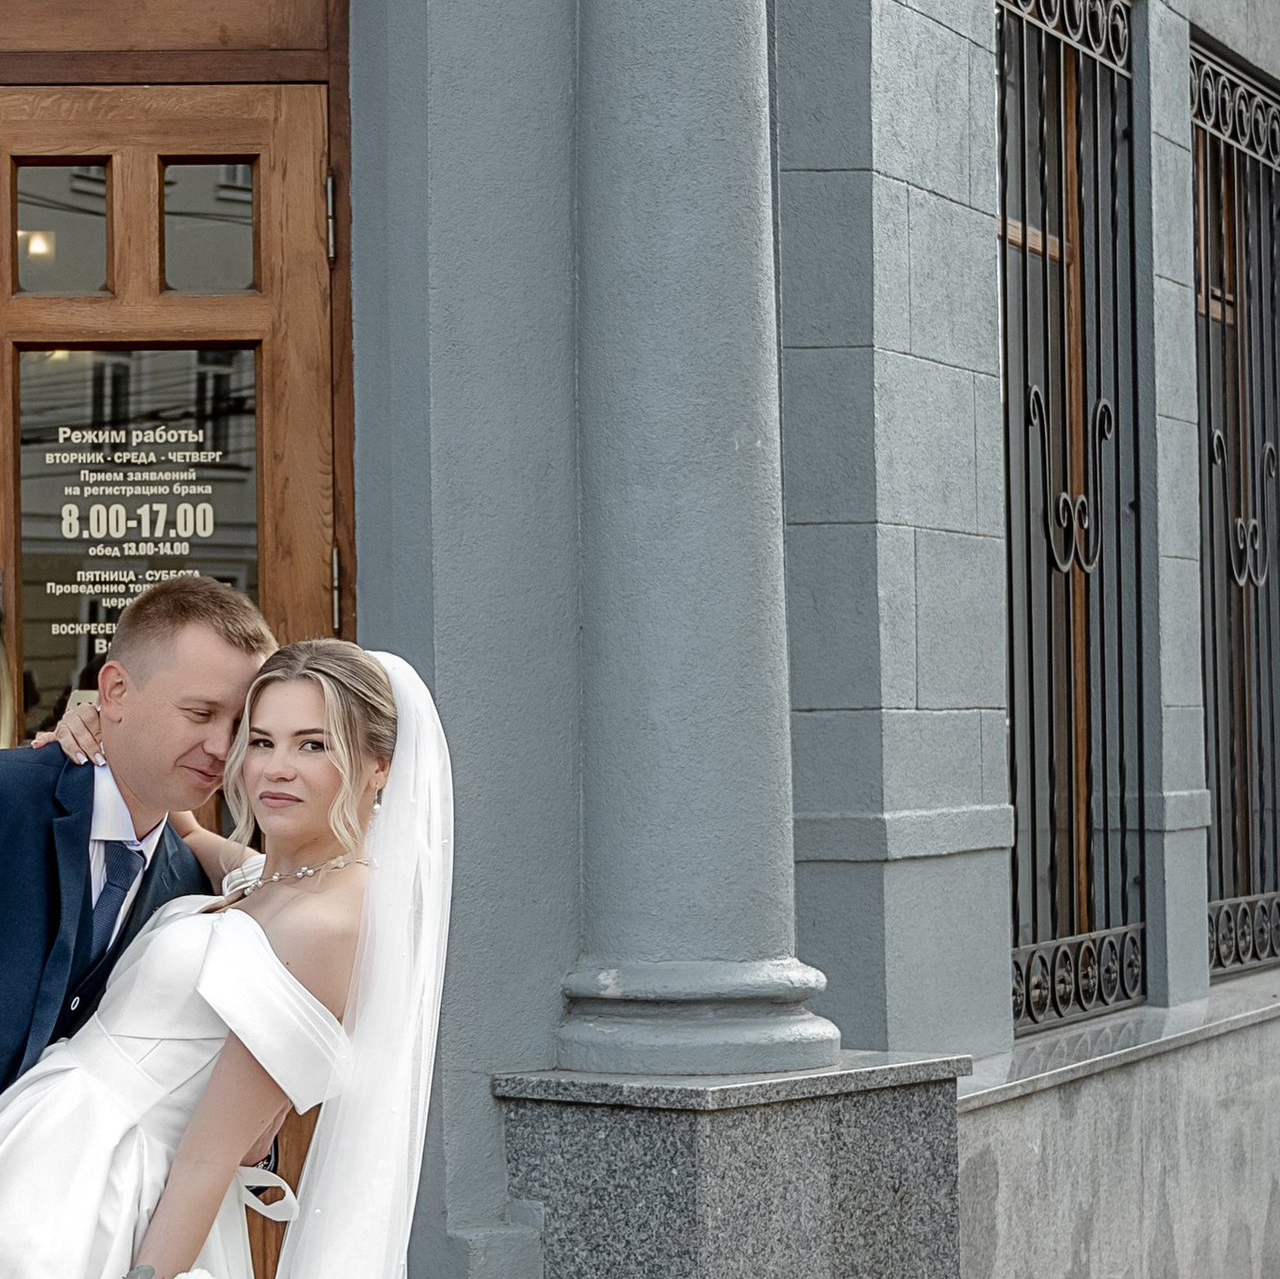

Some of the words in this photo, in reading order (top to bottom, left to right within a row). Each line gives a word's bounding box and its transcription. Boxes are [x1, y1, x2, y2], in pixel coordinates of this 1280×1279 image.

[58, 427, 126, 444] Режим
[132, 426, 204, 446] работы
[45, 452, 104, 464] ВТОРНИК
[114, 452, 156, 464] СРЕДА
[168, 451, 223, 463] ЧЕТВЕРГ
[80, 470, 124, 483] Прием
[127, 469, 196, 481] заявлений
[64, 486, 80, 496] на
[84, 485, 170, 497] регистрацию
[173, 483, 212, 497] брака
[61, 502, 214, 538] 8.00-17.00
[88, 544, 120, 557] обед
[122, 542, 190, 555] 13.00-14.00
[77, 570, 136, 583] ПЯТНИЦА
[46, 583, 126, 596] Проведение
